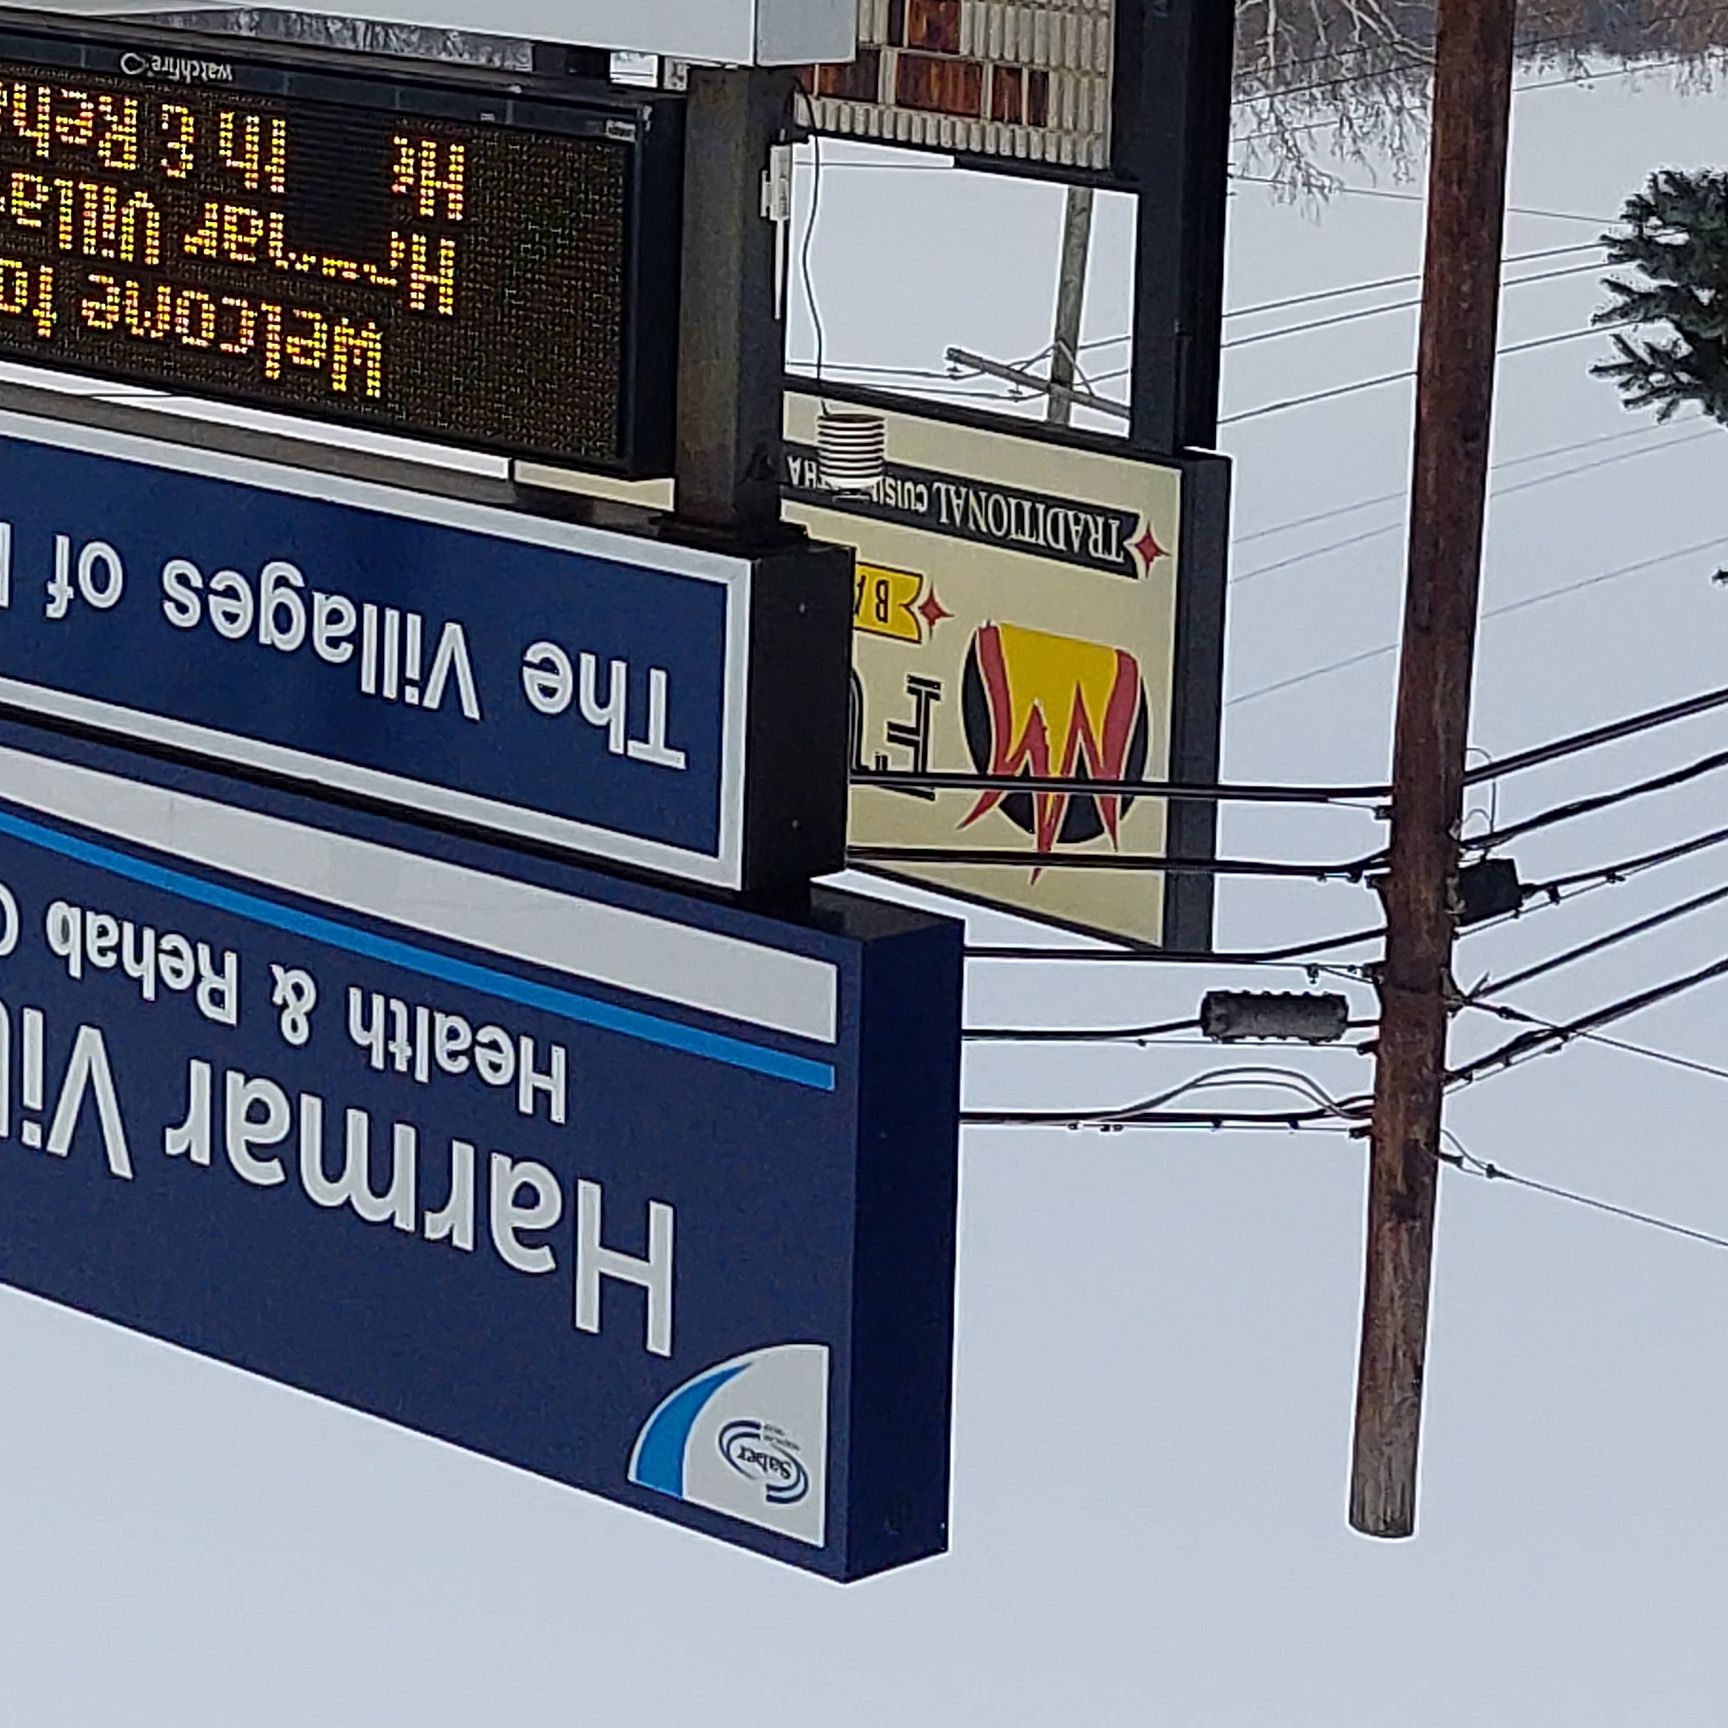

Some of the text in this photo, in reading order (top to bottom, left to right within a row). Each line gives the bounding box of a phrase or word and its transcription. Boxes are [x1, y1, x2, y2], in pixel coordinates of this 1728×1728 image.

[151, 55, 234, 82] watchfire
[80, 273, 382, 398] Welcome
[45, 533, 122, 619] of
[931, 481, 1126, 565] TRADITIONAL
[161, 558, 481, 723] Villages
[522, 641, 686, 770] The
[44, 899, 238, 1028] Rehab
[269, 961, 317, 1046] &
[346, 985, 568, 1124] Health
[164, 1060, 675, 1359] Harmar
